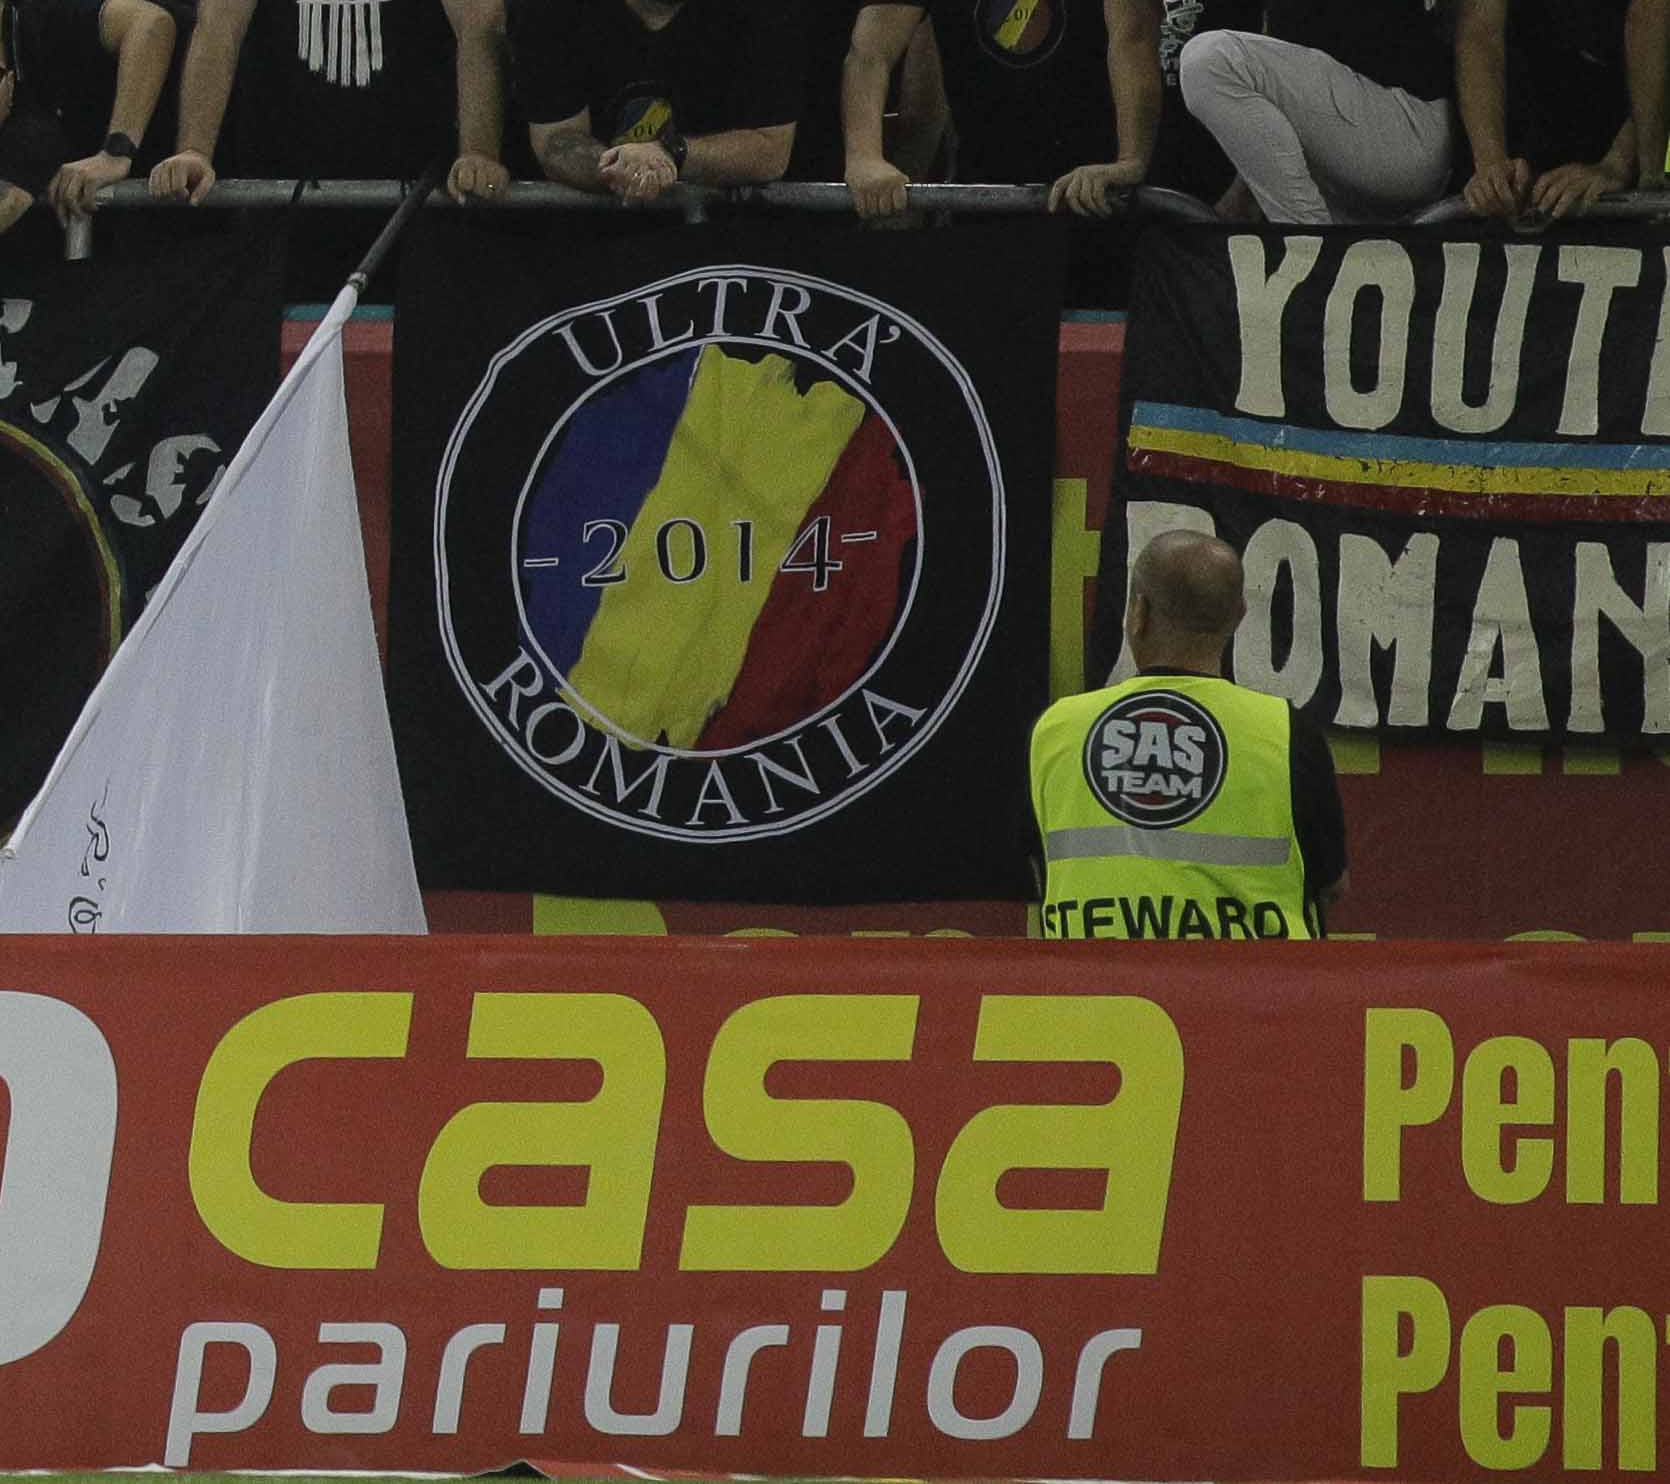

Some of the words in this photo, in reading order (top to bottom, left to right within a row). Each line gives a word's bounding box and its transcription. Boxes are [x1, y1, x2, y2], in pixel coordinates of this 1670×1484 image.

[480, 646, 928, 825] ROMANIA
[1101, 718, 1208, 775] SAS
[1101, 768, 1203, 800] TEAM
[187, 991, 1187, 1275] casa
[1363, 1006, 1670, 1205] Pen
[163, 1286, 1143, 1468] pariurilor
[1359, 1275, 1670, 1472] Pen
